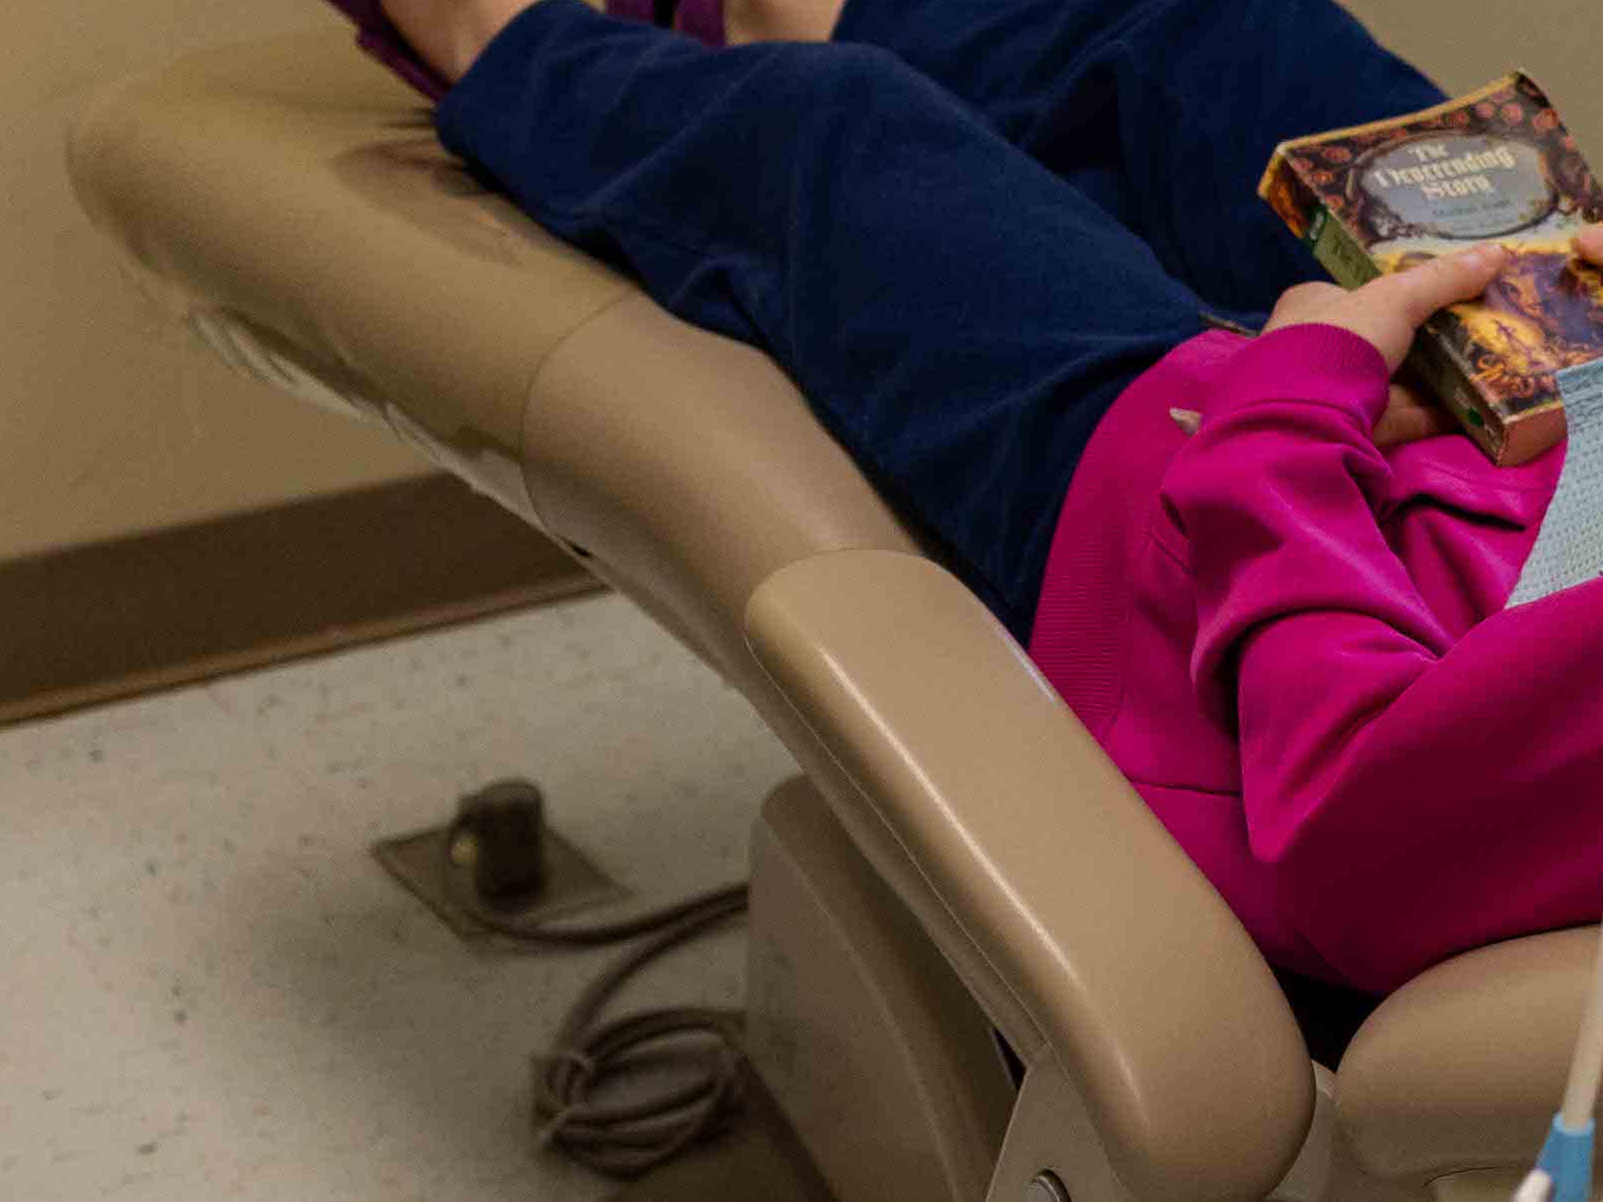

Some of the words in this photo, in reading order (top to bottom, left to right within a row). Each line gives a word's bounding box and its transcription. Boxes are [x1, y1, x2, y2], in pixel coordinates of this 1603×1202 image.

[1409, 144, 1448, 162] The
[1374, 146, 1516, 187] Neverending
[1421, 175, 1494, 199] Story
